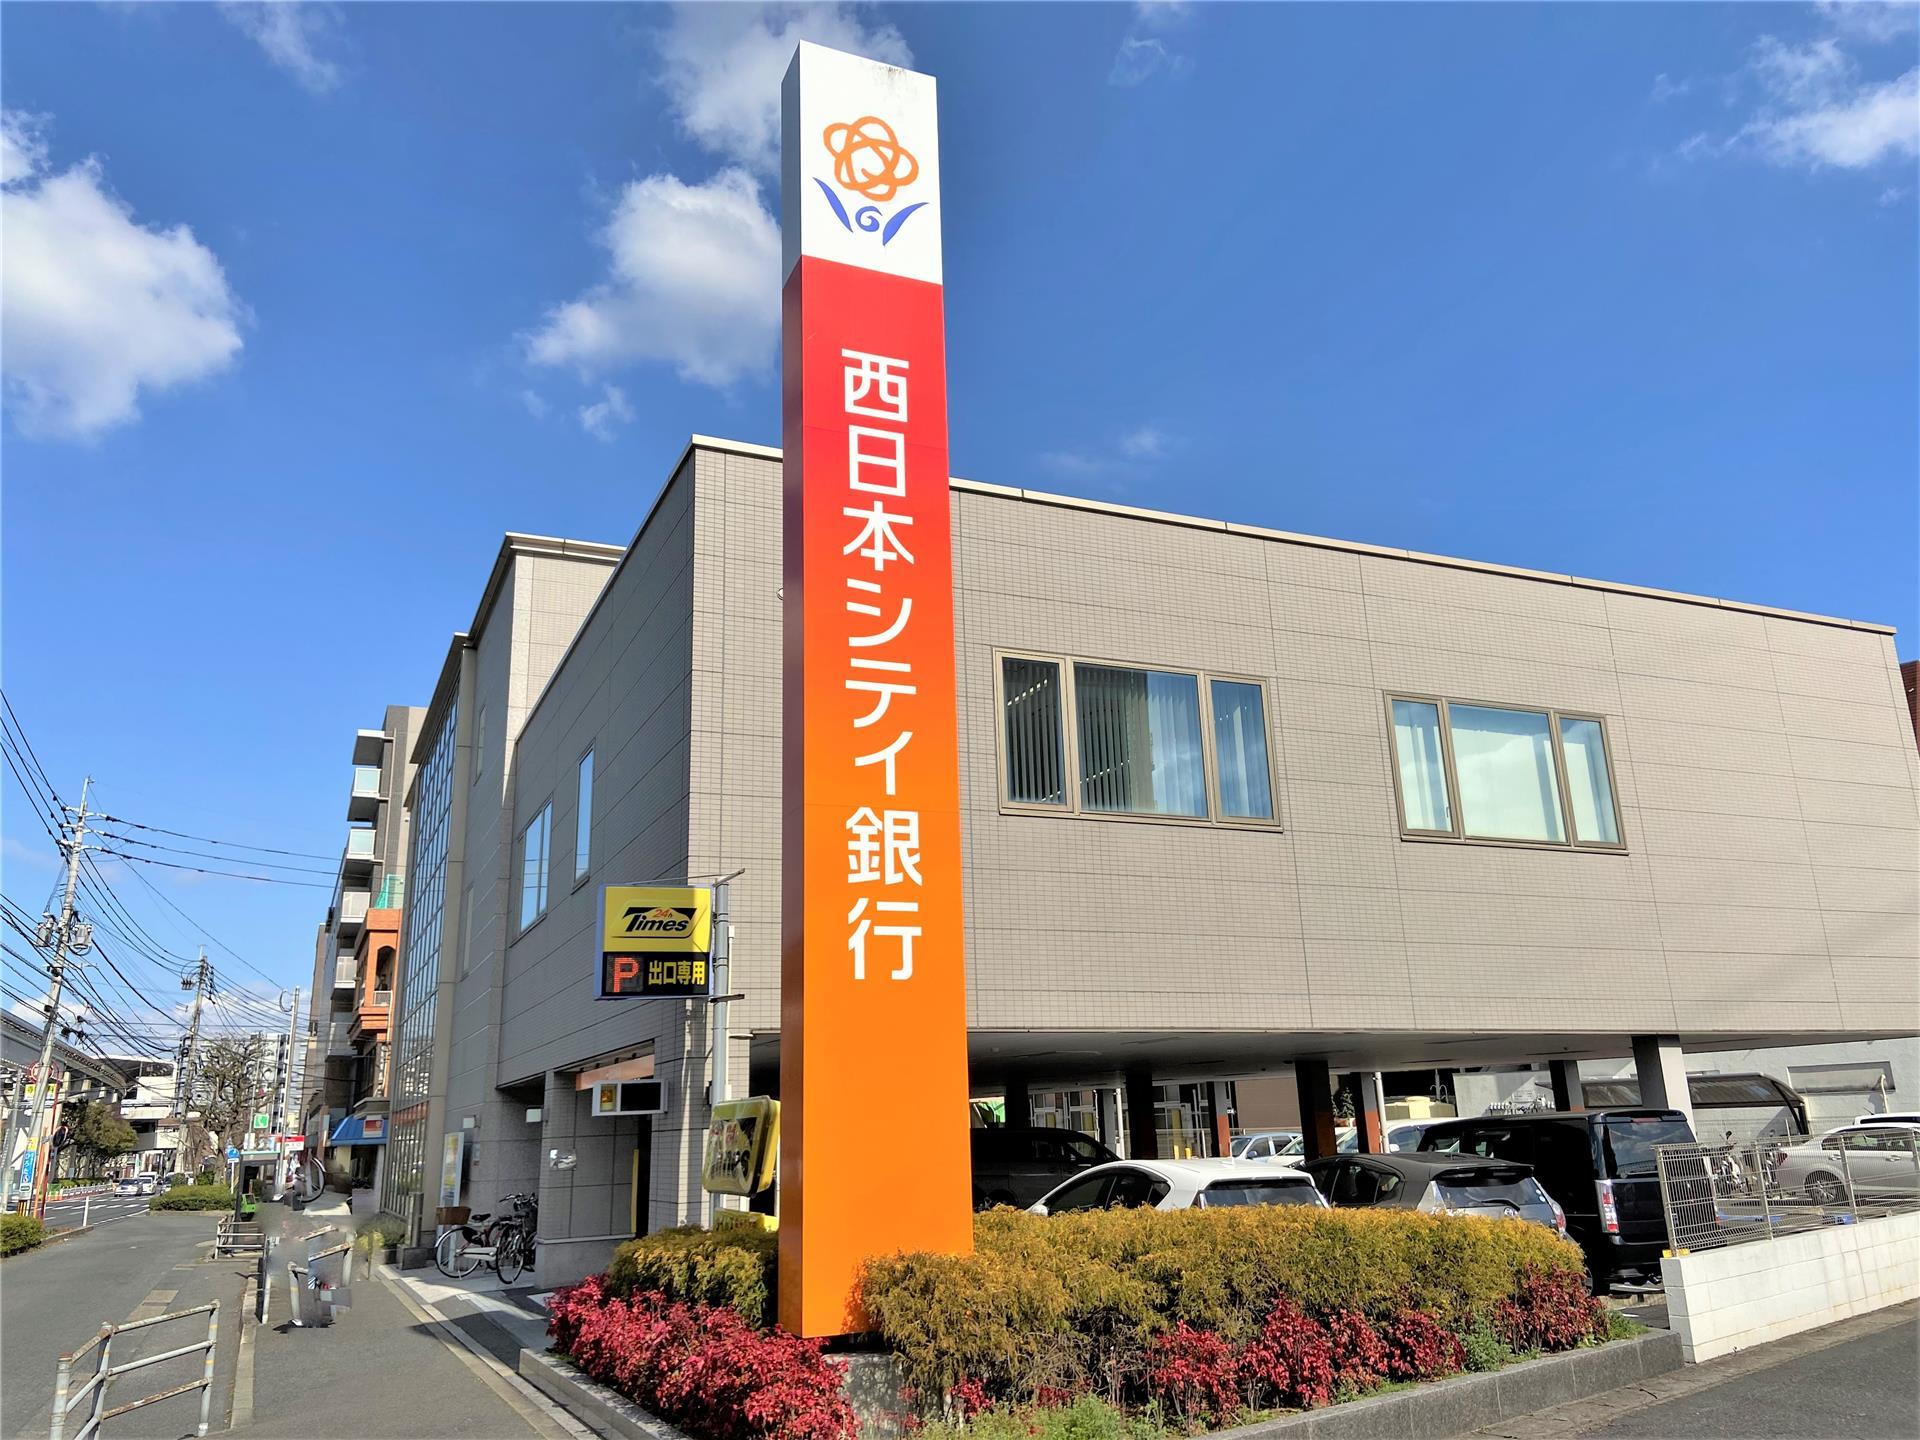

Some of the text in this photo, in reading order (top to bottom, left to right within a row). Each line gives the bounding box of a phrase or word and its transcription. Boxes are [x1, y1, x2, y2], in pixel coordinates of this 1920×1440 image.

[841, 348, 923, 981] 西日本シティ銀行
[623, 907, 697, 932] Times
[613, 957, 639, 993] P
[648, 960, 706, 985] 出口専用
